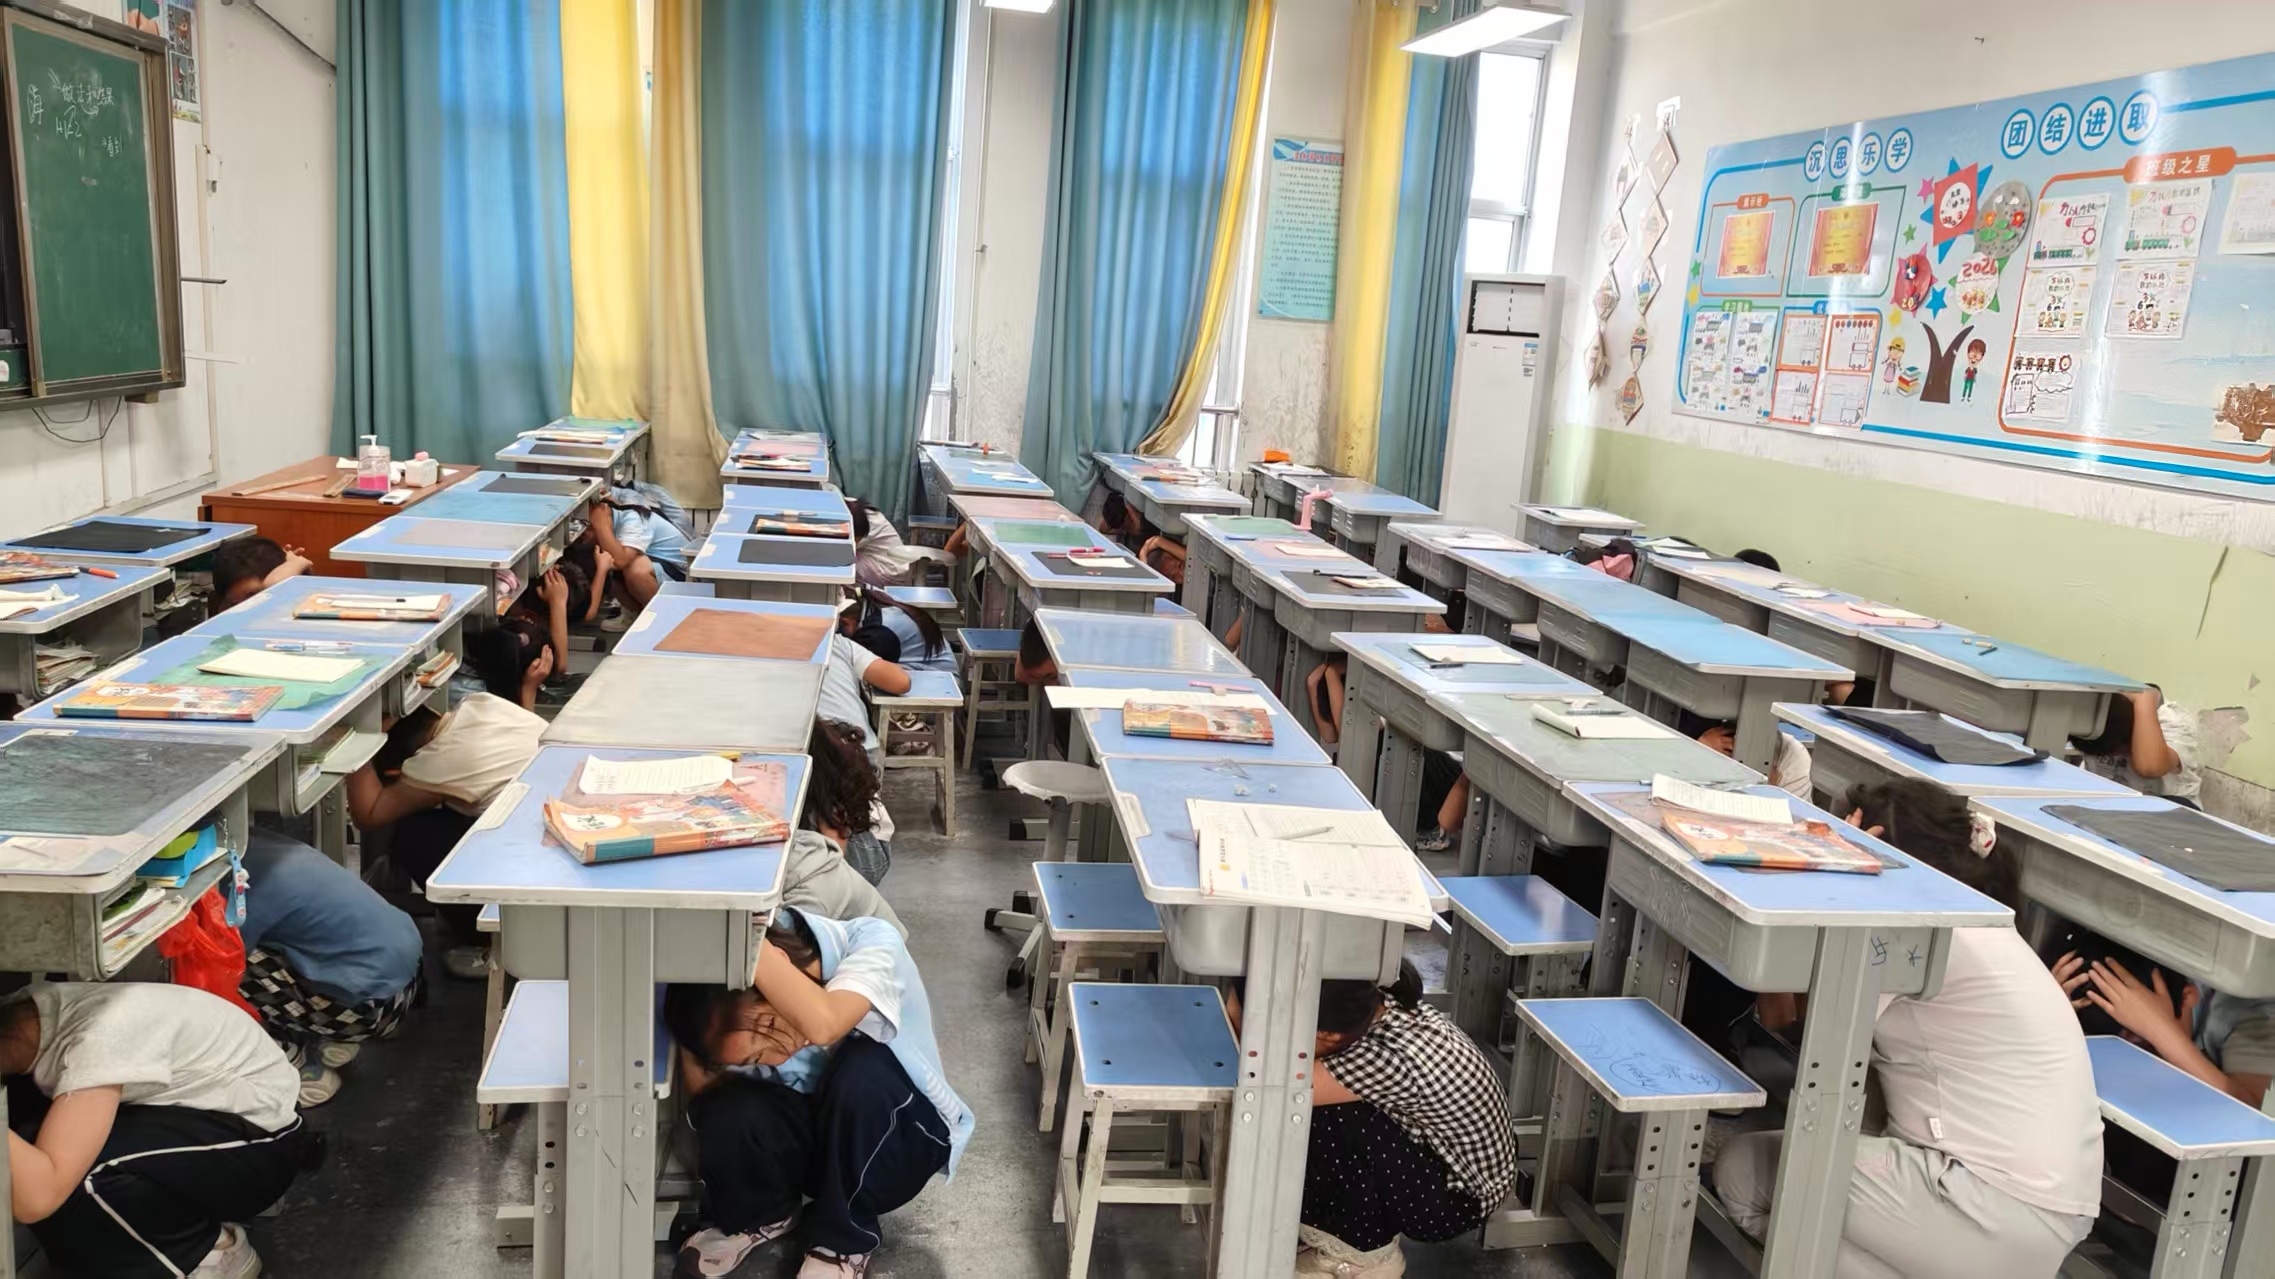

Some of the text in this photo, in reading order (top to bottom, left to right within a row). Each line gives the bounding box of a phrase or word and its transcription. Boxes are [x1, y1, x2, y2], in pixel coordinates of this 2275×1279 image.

[2007, 102, 2149, 148] 团结进取
[1808, 138, 1908, 172] 沉思乐学
[2144, 154, 2211, 177] 班级之星
[1962, 257, 1998, 278] 2026
